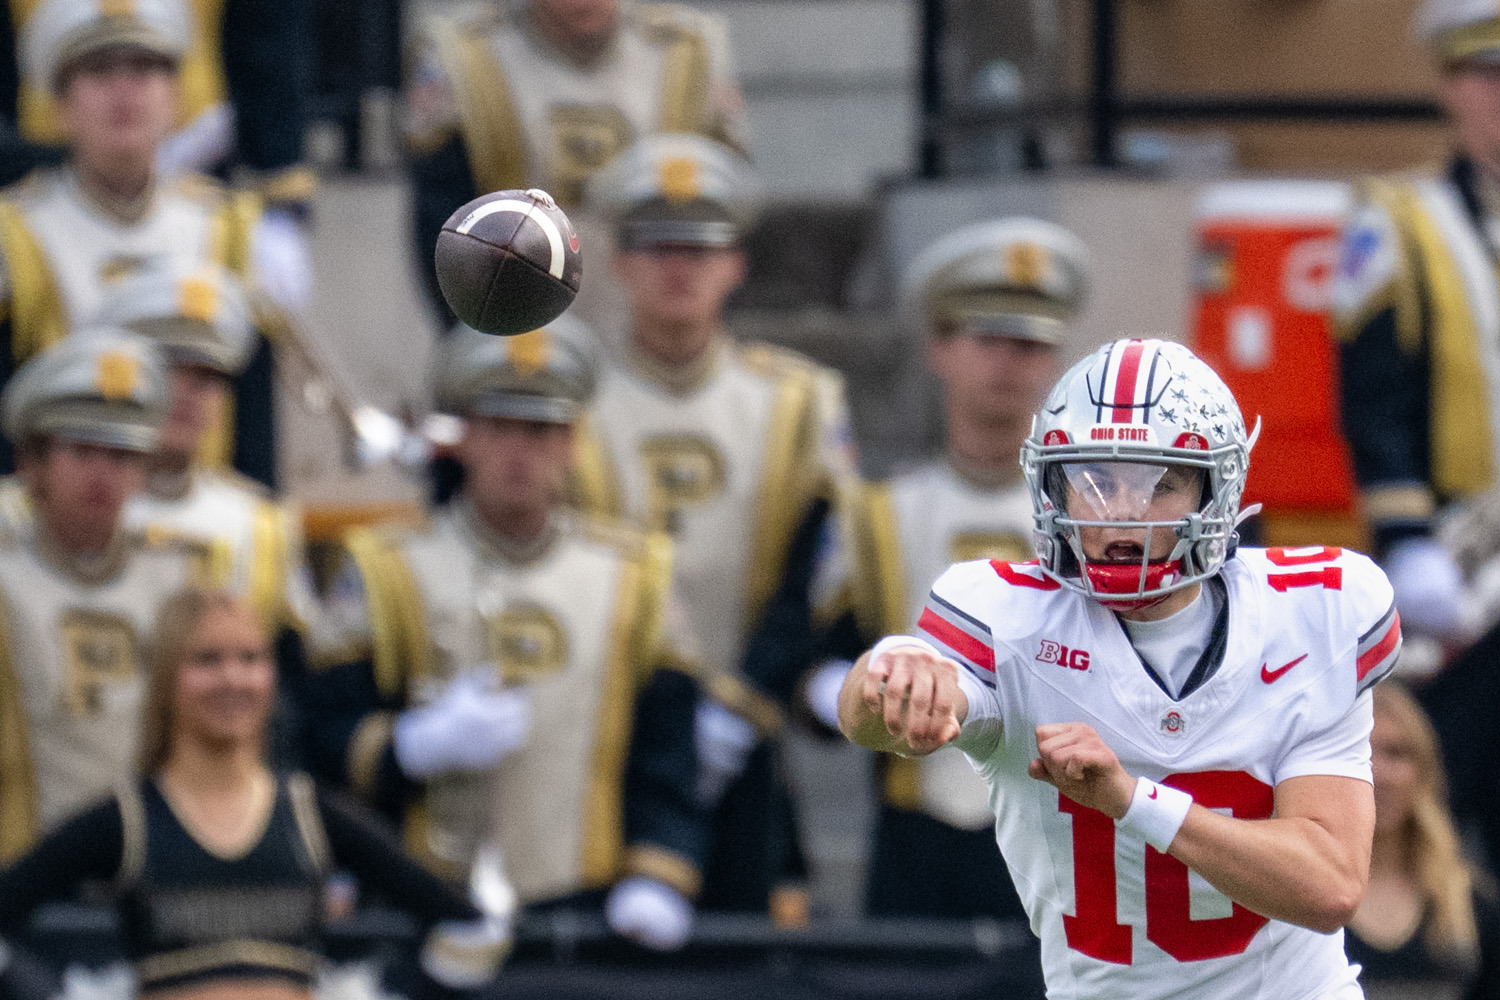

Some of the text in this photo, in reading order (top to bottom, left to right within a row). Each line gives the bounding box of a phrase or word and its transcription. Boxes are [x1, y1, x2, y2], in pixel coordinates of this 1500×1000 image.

[1091, 428, 1148, 441] OHIO STATE
[1036, 639, 1090, 671] BIG
[1058, 770, 1274, 966] 10
